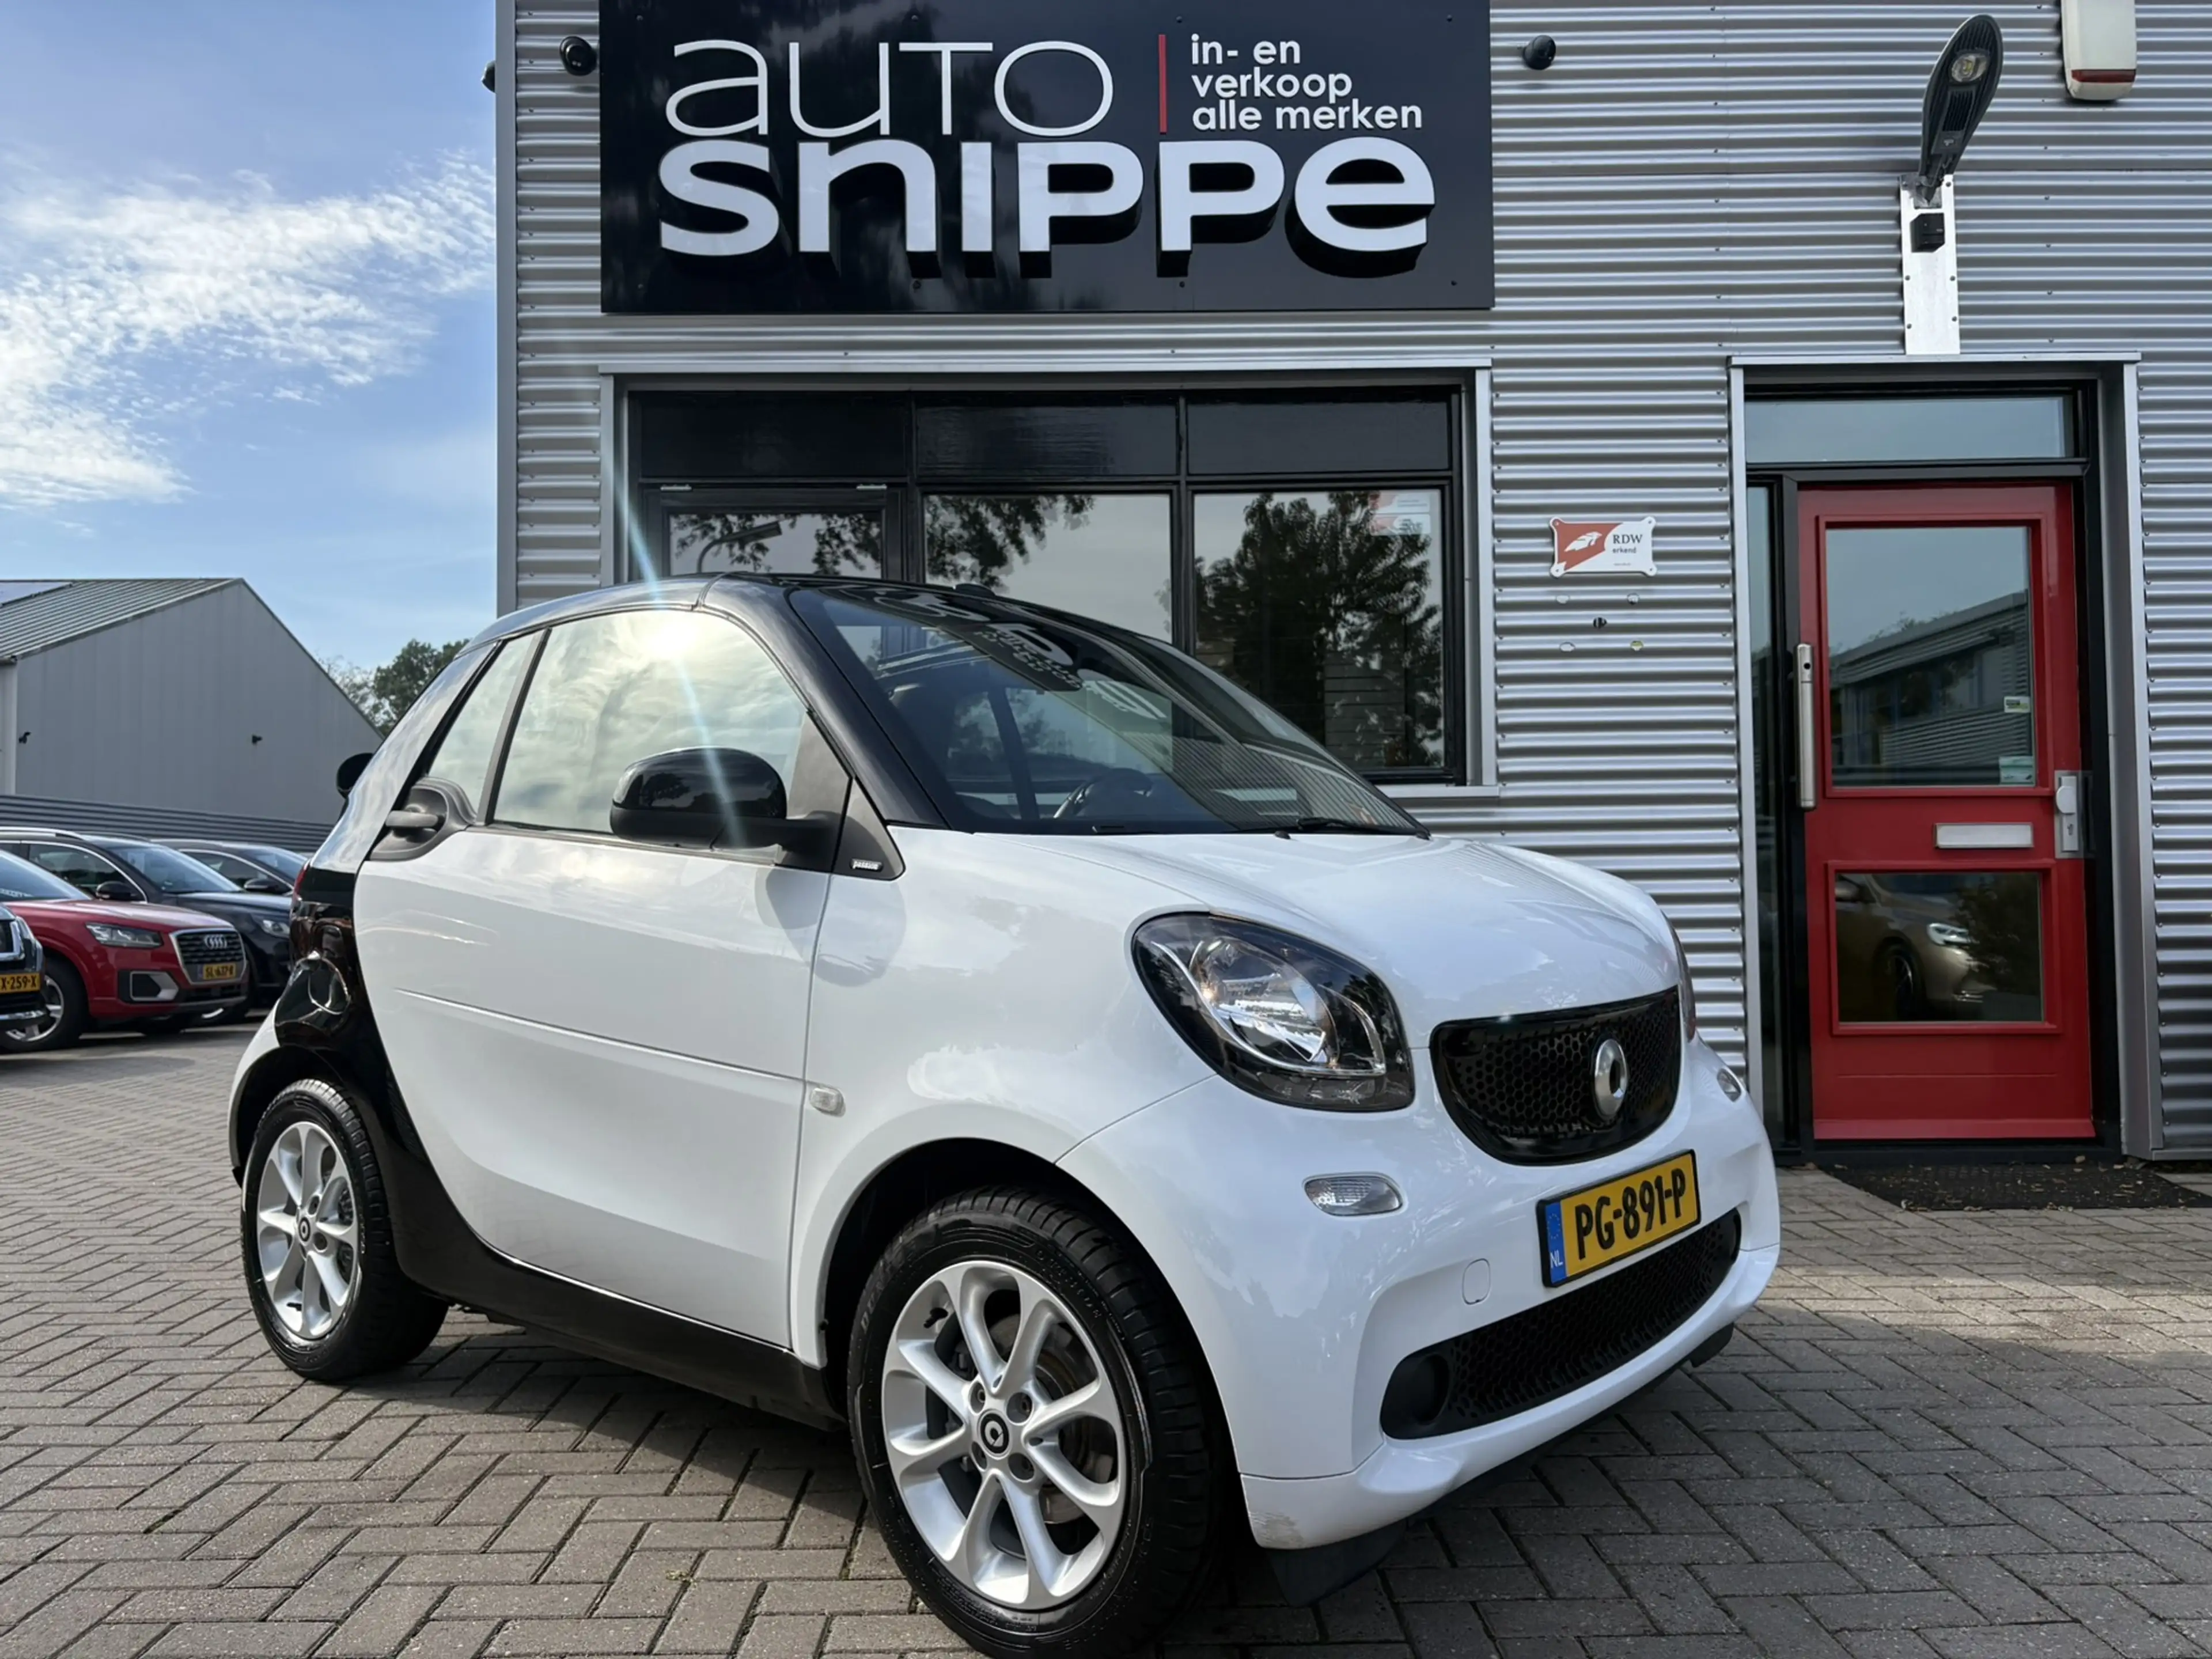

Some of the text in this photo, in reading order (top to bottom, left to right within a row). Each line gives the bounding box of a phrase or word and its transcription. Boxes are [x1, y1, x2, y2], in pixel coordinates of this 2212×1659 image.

[1192, 33, 1300, 65] in- en
[1192, 66, 1352, 104] verkoop
[1192, 98, 1422, 130] alle merken
[1612, 546, 1637, 554] erkend
[1613, 534, 1643, 544] RDW
[1575, 1168, 1686, 1260] PG-891-P
[1550, 1251, 1563, 1269] NL
